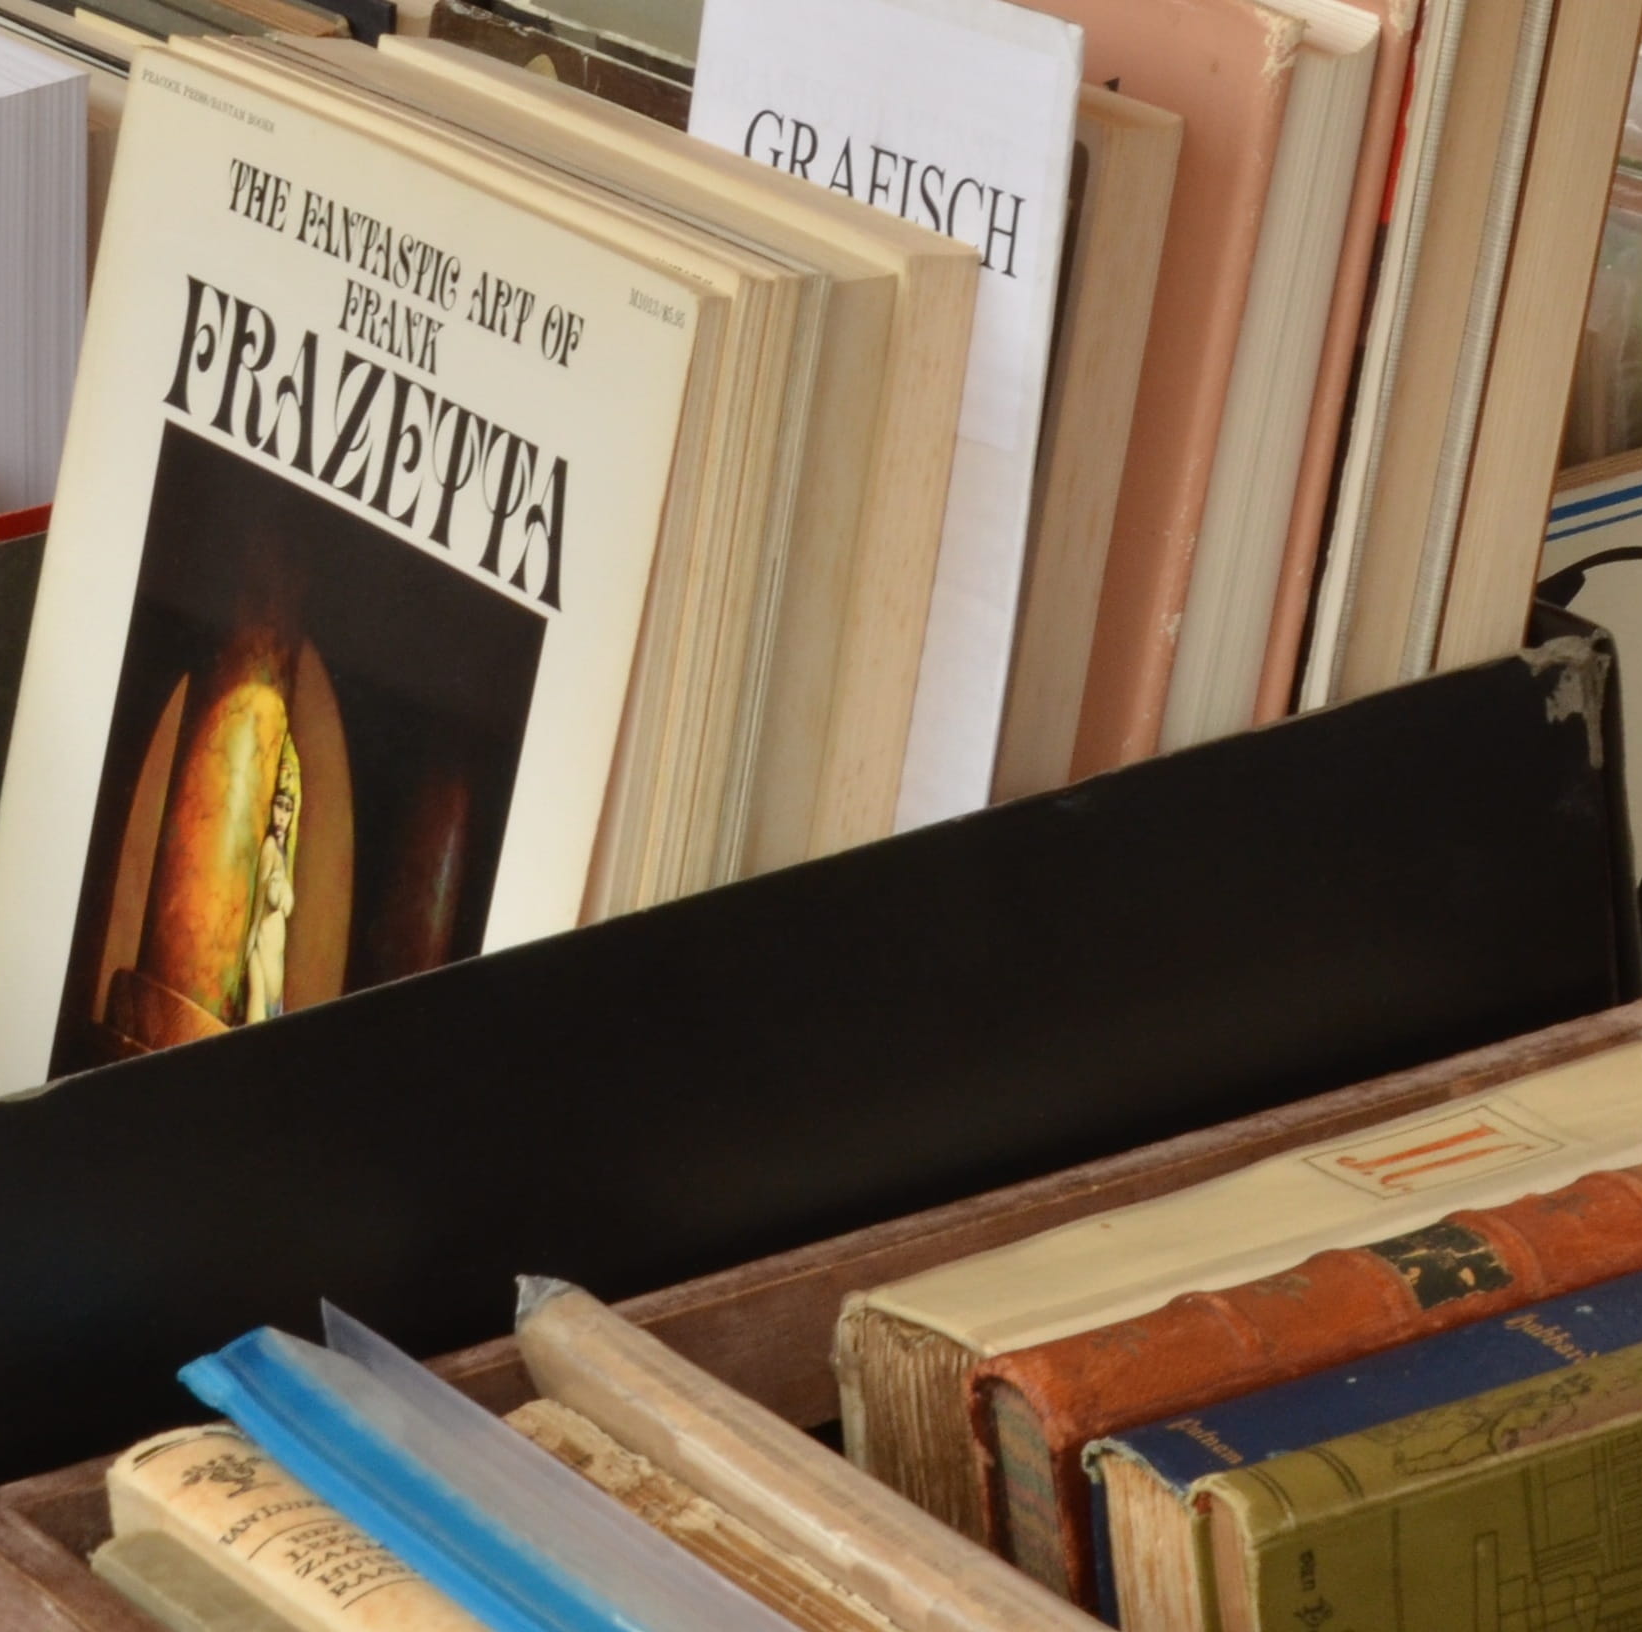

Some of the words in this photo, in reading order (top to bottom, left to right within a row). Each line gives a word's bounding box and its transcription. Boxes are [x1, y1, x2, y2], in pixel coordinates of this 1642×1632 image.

[229, 158, 291, 231] THE
[296, 190, 461, 311] FANTASTIC
[466, 271, 535, 347] ART
[540, 302, 585, 368] OF
[338, 278, 445, 375] FRANK
[162, 274, 568, 612] FRAZETTA
